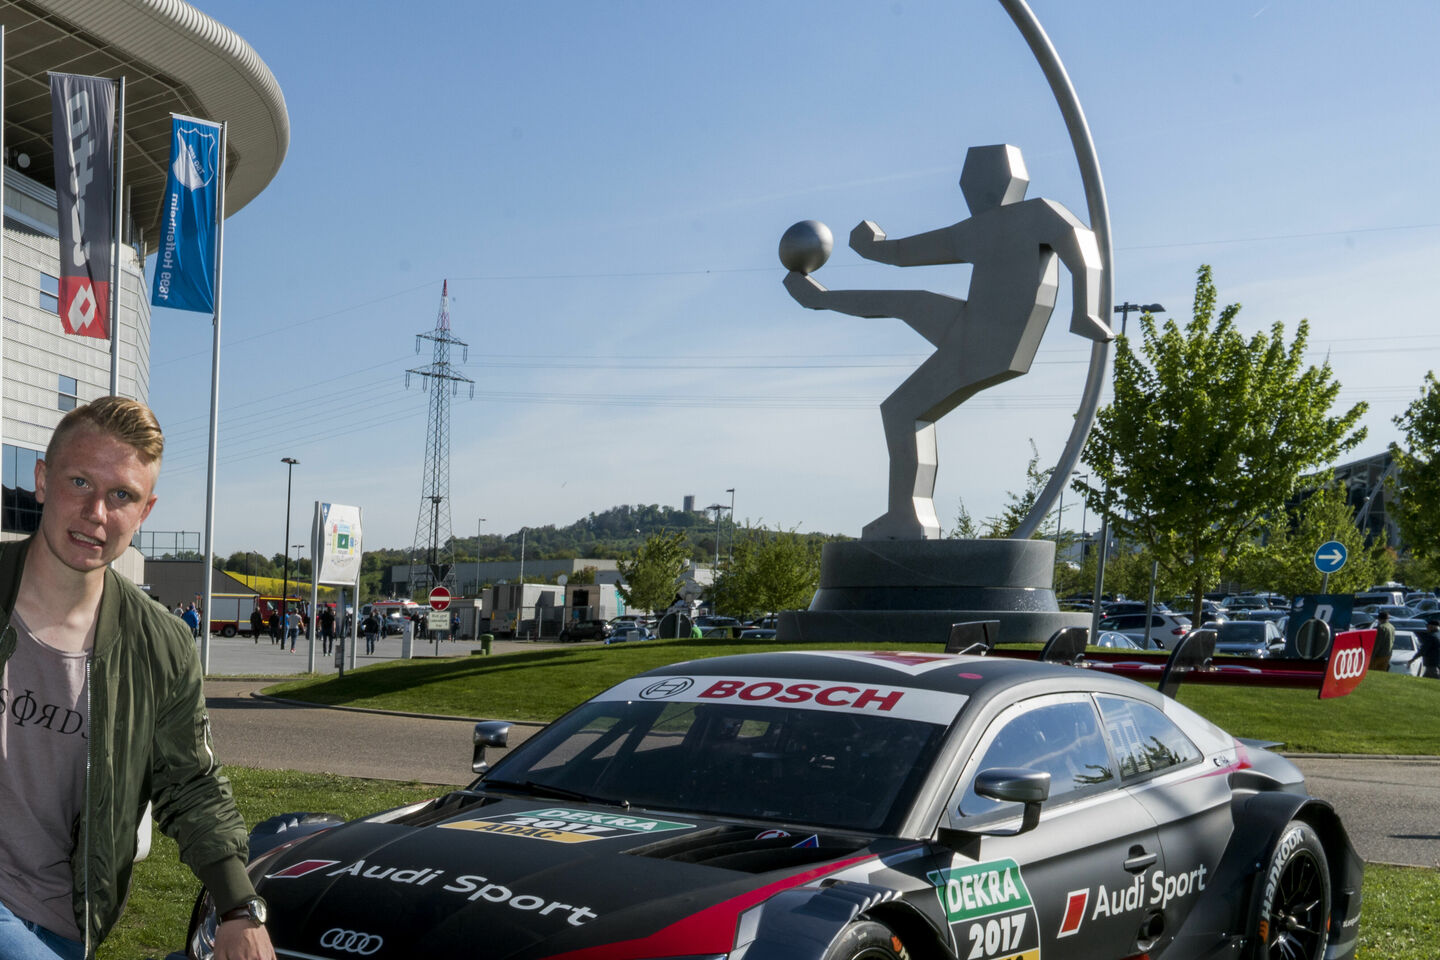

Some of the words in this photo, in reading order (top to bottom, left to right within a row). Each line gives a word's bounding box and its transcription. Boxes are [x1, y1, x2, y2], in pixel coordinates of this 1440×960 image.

[696, 680, 905, 712] BOSCH
[474, 823, 563, 840] ADAC
[502, 816, 618, 833] 2017
[536, 809, 661, 831] DEKRA
[328, 860, 445, 885] Audi
[443, 875, 600, 927] Sport
[947, 868, 1021, 914] DEKRA
[1092, 874, 1145, 921] Audi
[1149, 864, 1208, 909] Sport
[966, 914, 1028, 960] 2017
